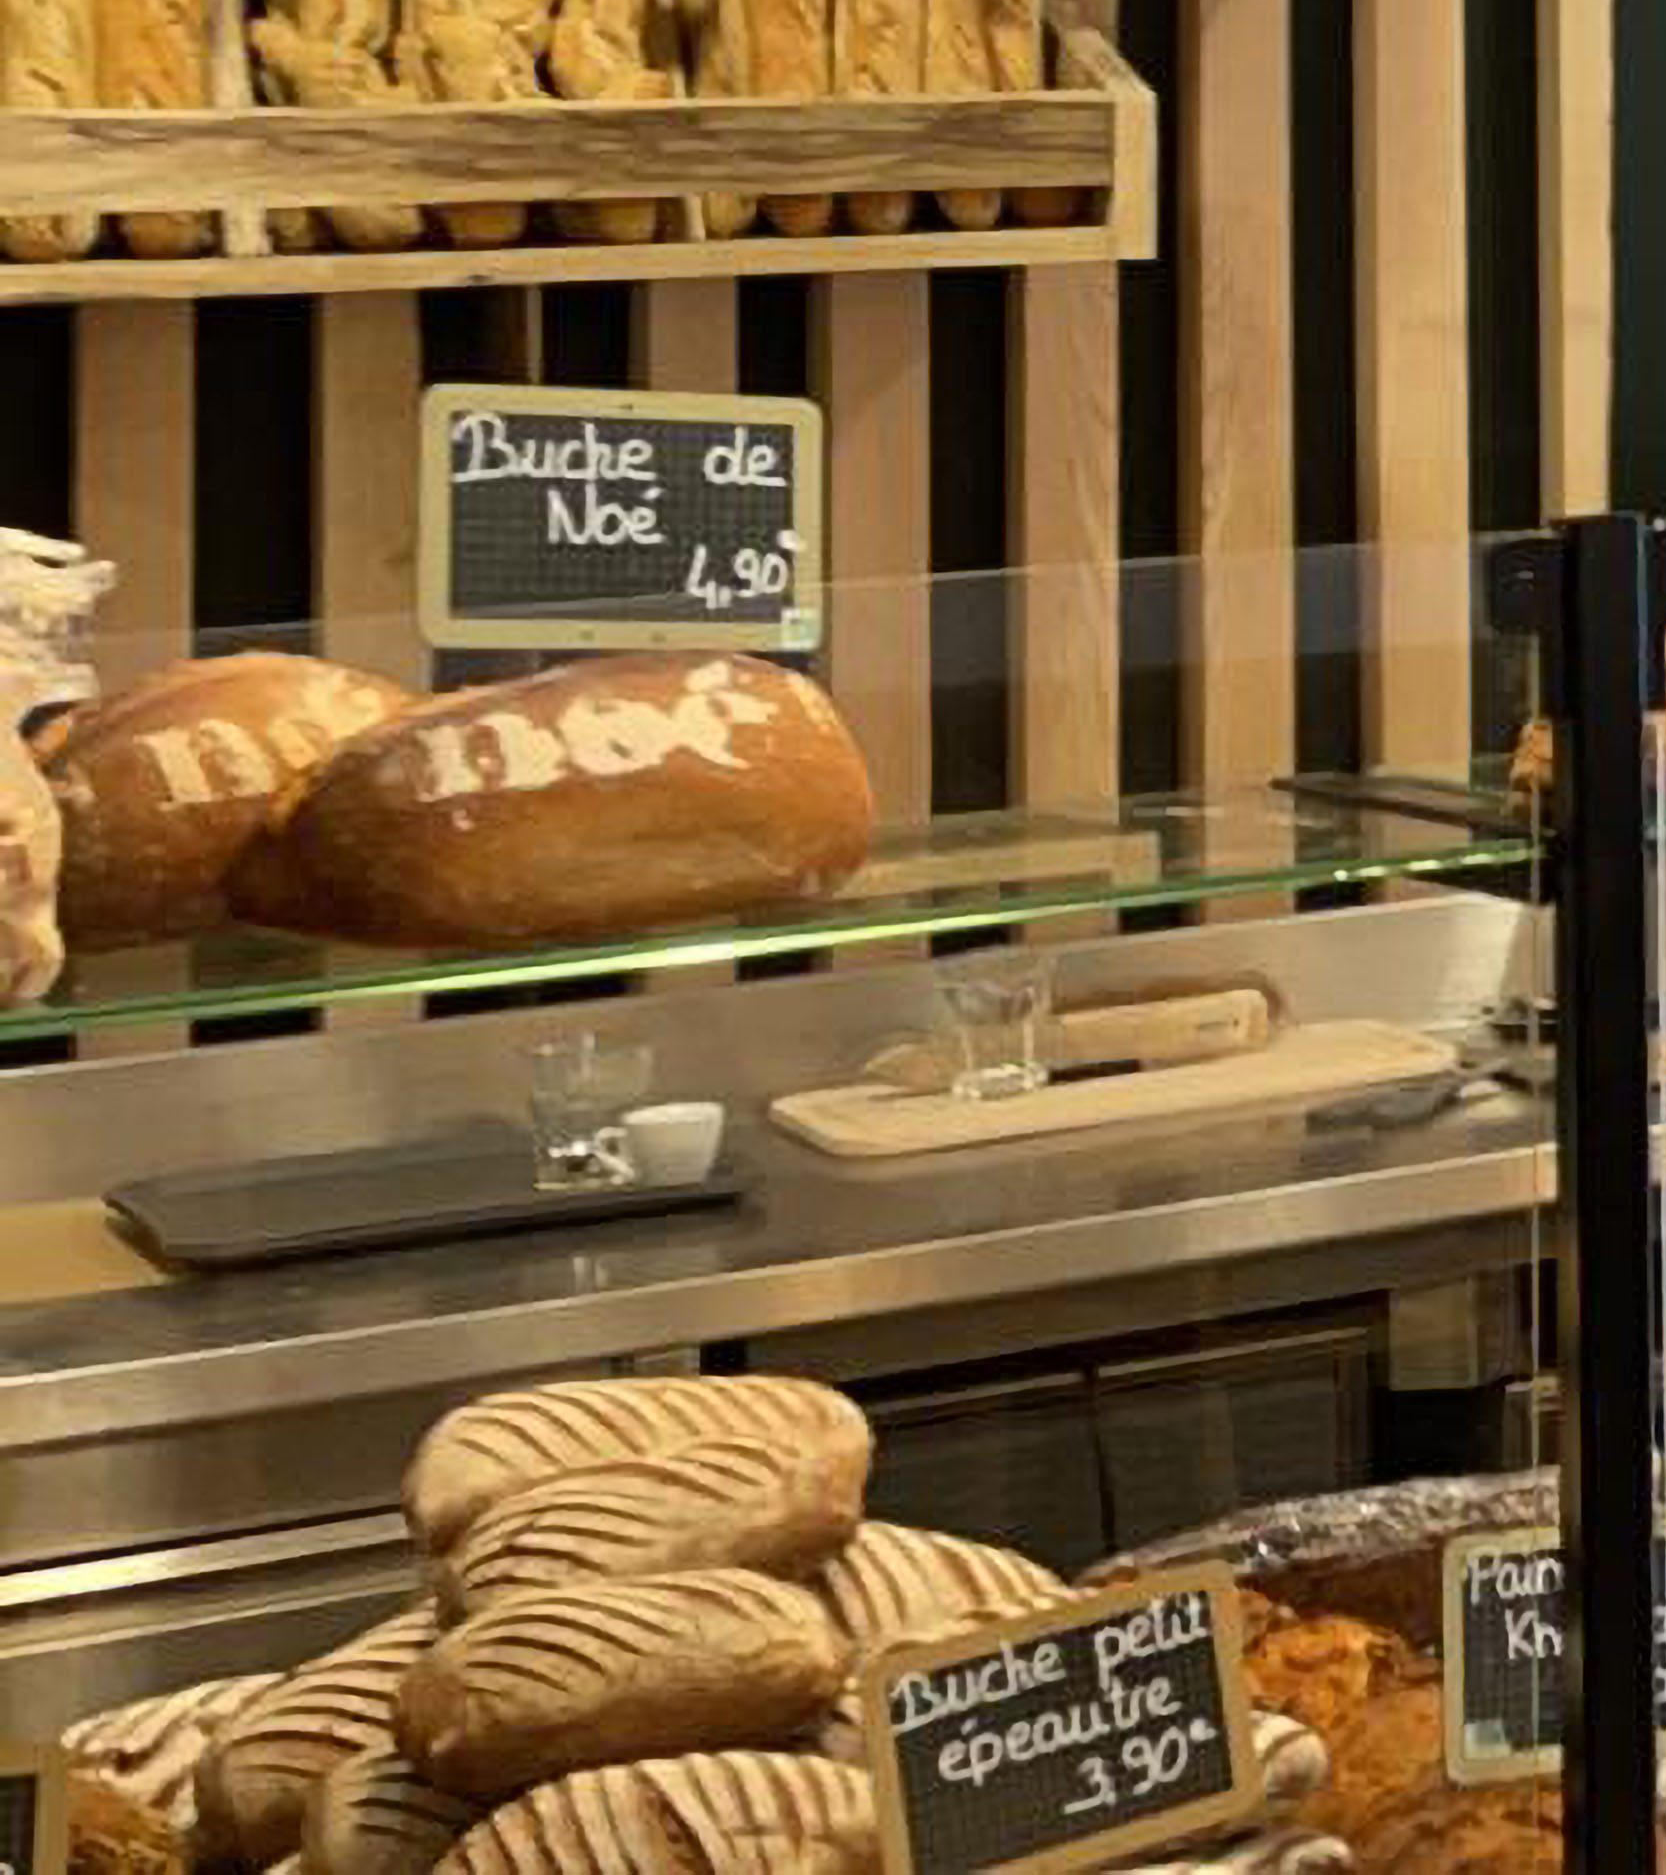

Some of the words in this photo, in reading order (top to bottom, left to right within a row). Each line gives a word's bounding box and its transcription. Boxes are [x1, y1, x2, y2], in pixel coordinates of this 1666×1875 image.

[452, 410, 657, 483] Buche
[703, 425, 787, 486] de
[546, 482, 667, 545] Noé
[1466, 1545, 1565, 1606] Pain
[889, 1639, 1067, 1734] Buche
[937, 1676, 1182, 1786] épeautre
